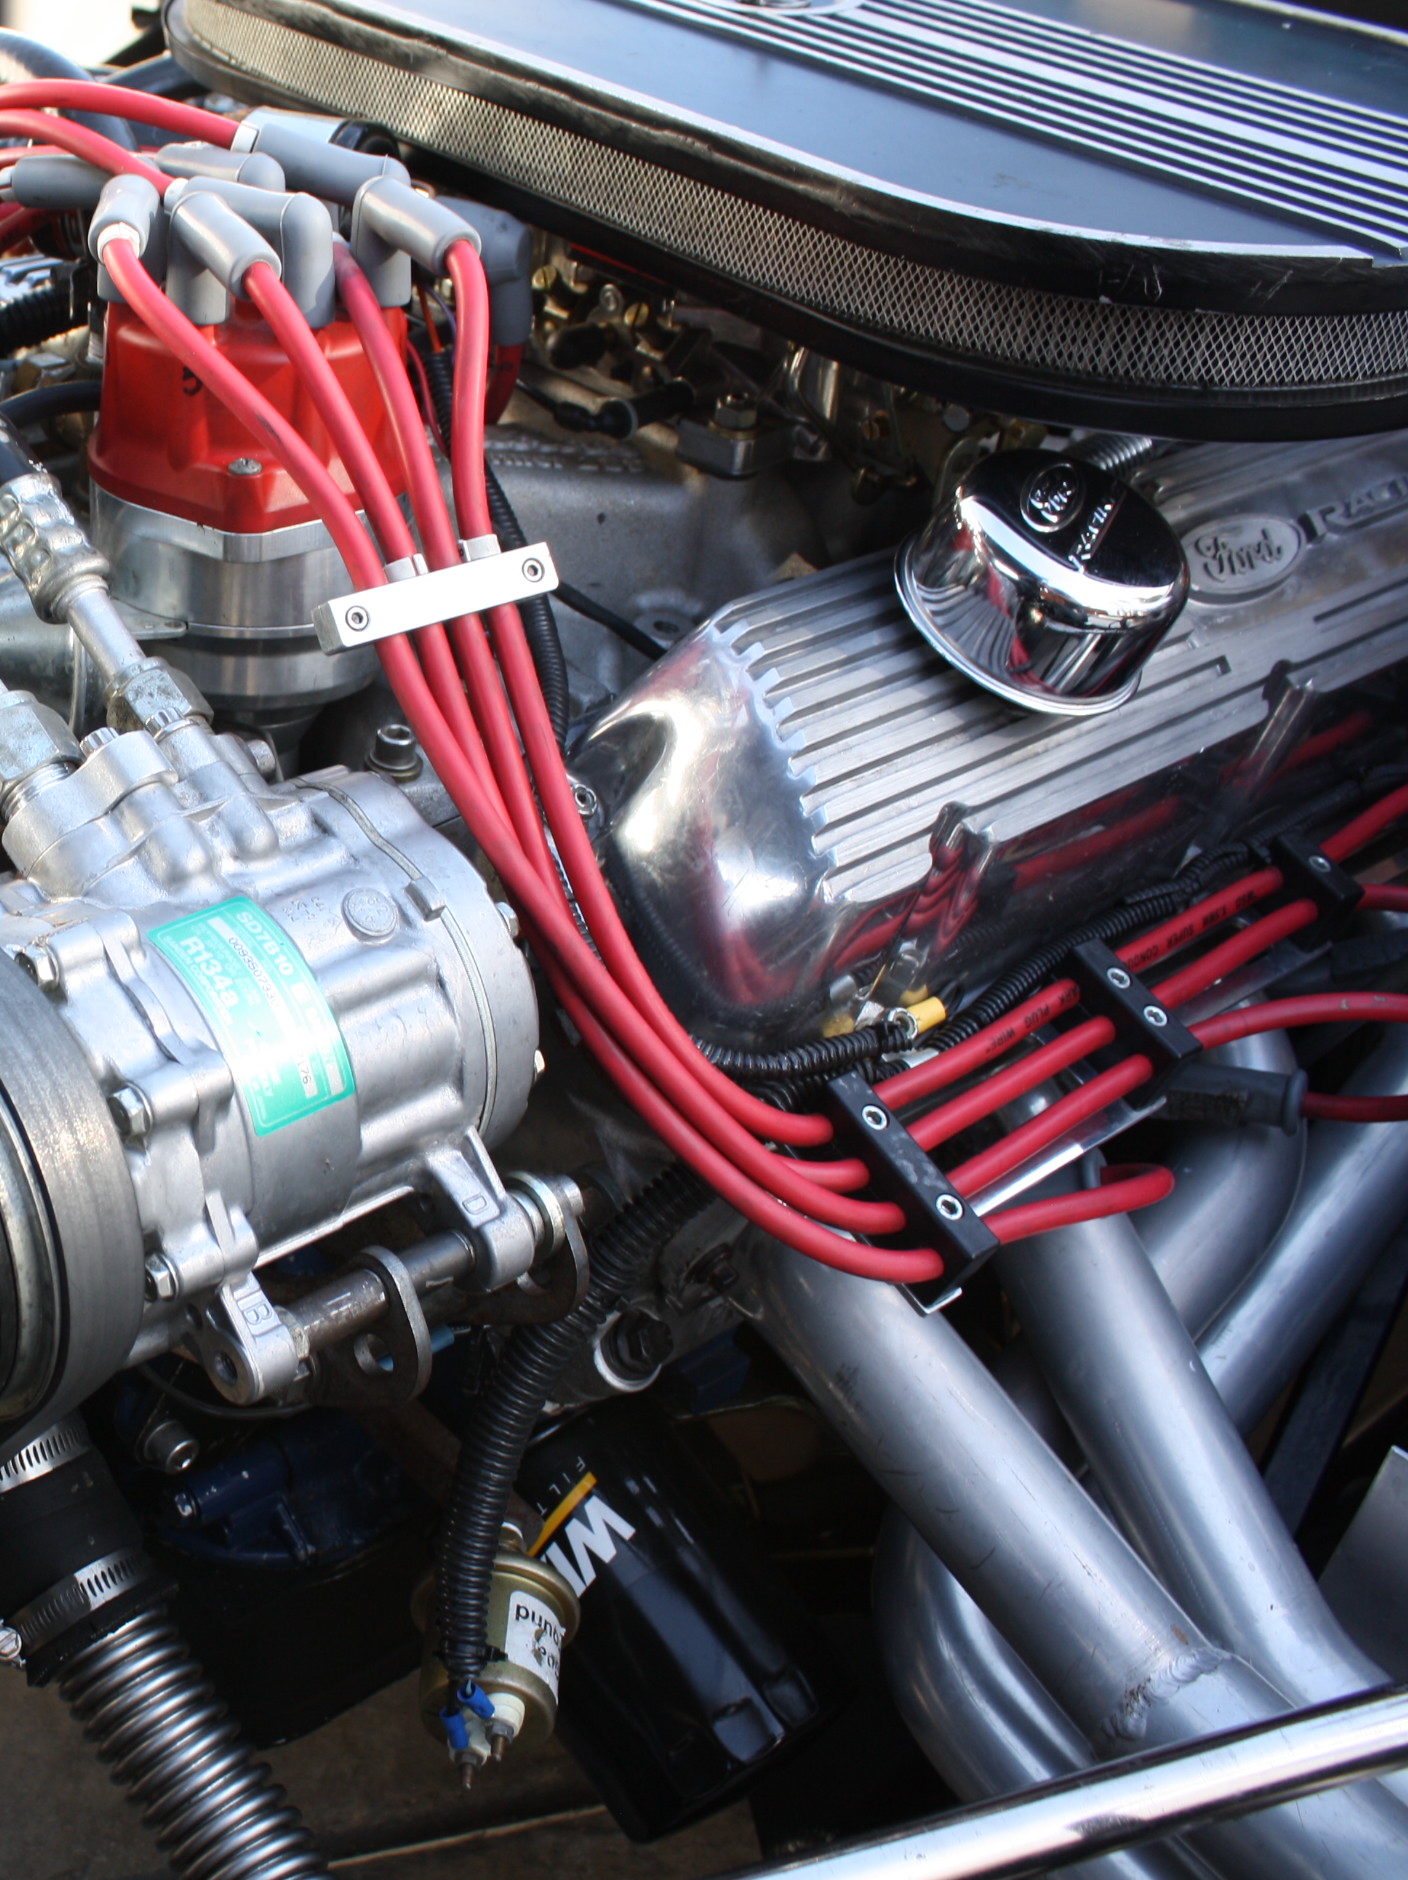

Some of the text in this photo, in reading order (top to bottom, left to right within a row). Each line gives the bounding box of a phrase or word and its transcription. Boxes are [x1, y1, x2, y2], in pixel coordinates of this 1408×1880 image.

[1195, 477, 1408, 582] Ford RACI
[180, 936, 241, 1008] R134a
[235, 911, 294, 976] SD7B10
[1024, 1004, 1051, 1029] PLUG
[537, 1456, 586, 1517] FILT
[541, 1495, 636, 1598] WI
[515, 1604, 559, 1646] ound
